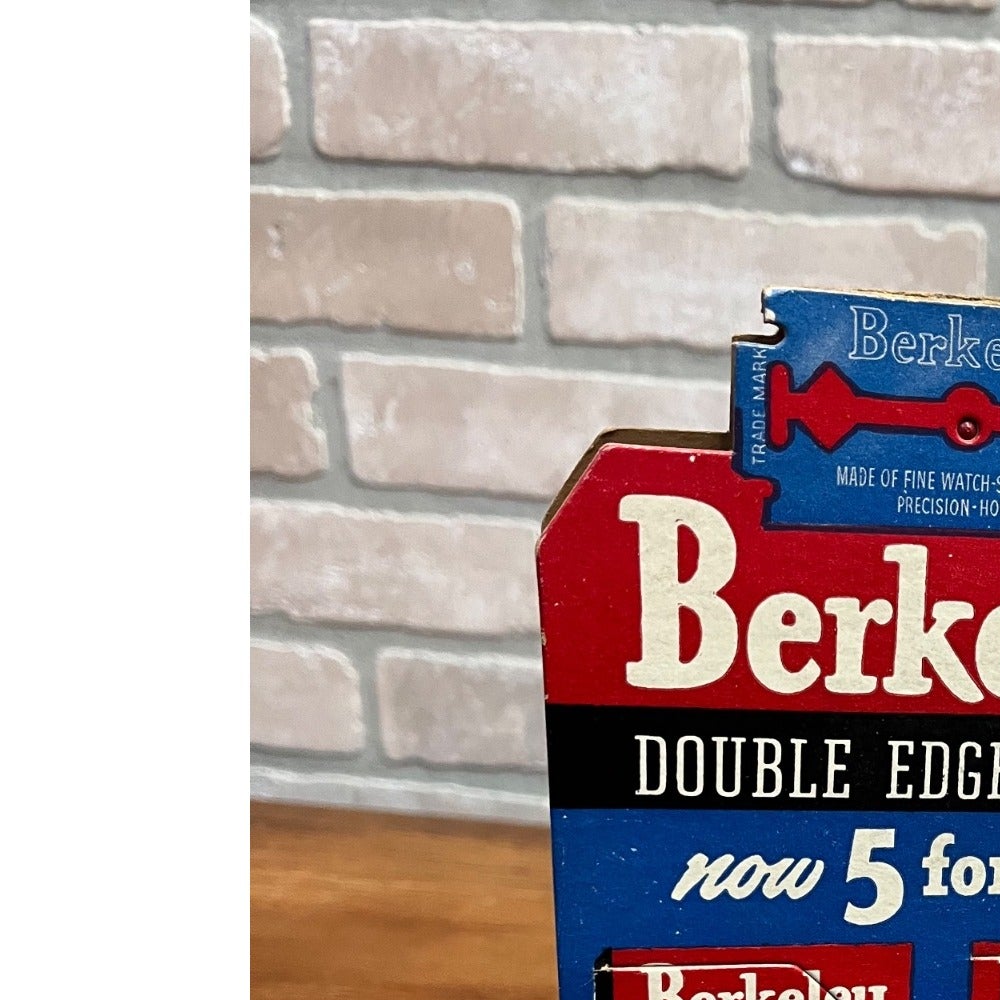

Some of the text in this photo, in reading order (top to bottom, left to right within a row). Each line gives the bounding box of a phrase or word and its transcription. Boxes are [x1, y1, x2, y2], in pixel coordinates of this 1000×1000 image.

[751, 347, 767, 465] TRADE MARK
[836, 465, 876, 487] MADE
[880, 468, 899, 488] OF
[904, 470, 936, 491] FINE
[634, 734, 852, 799] DOUBLE
[670, 847, 825, 901] now
[843, 827, 907, 926] 5
